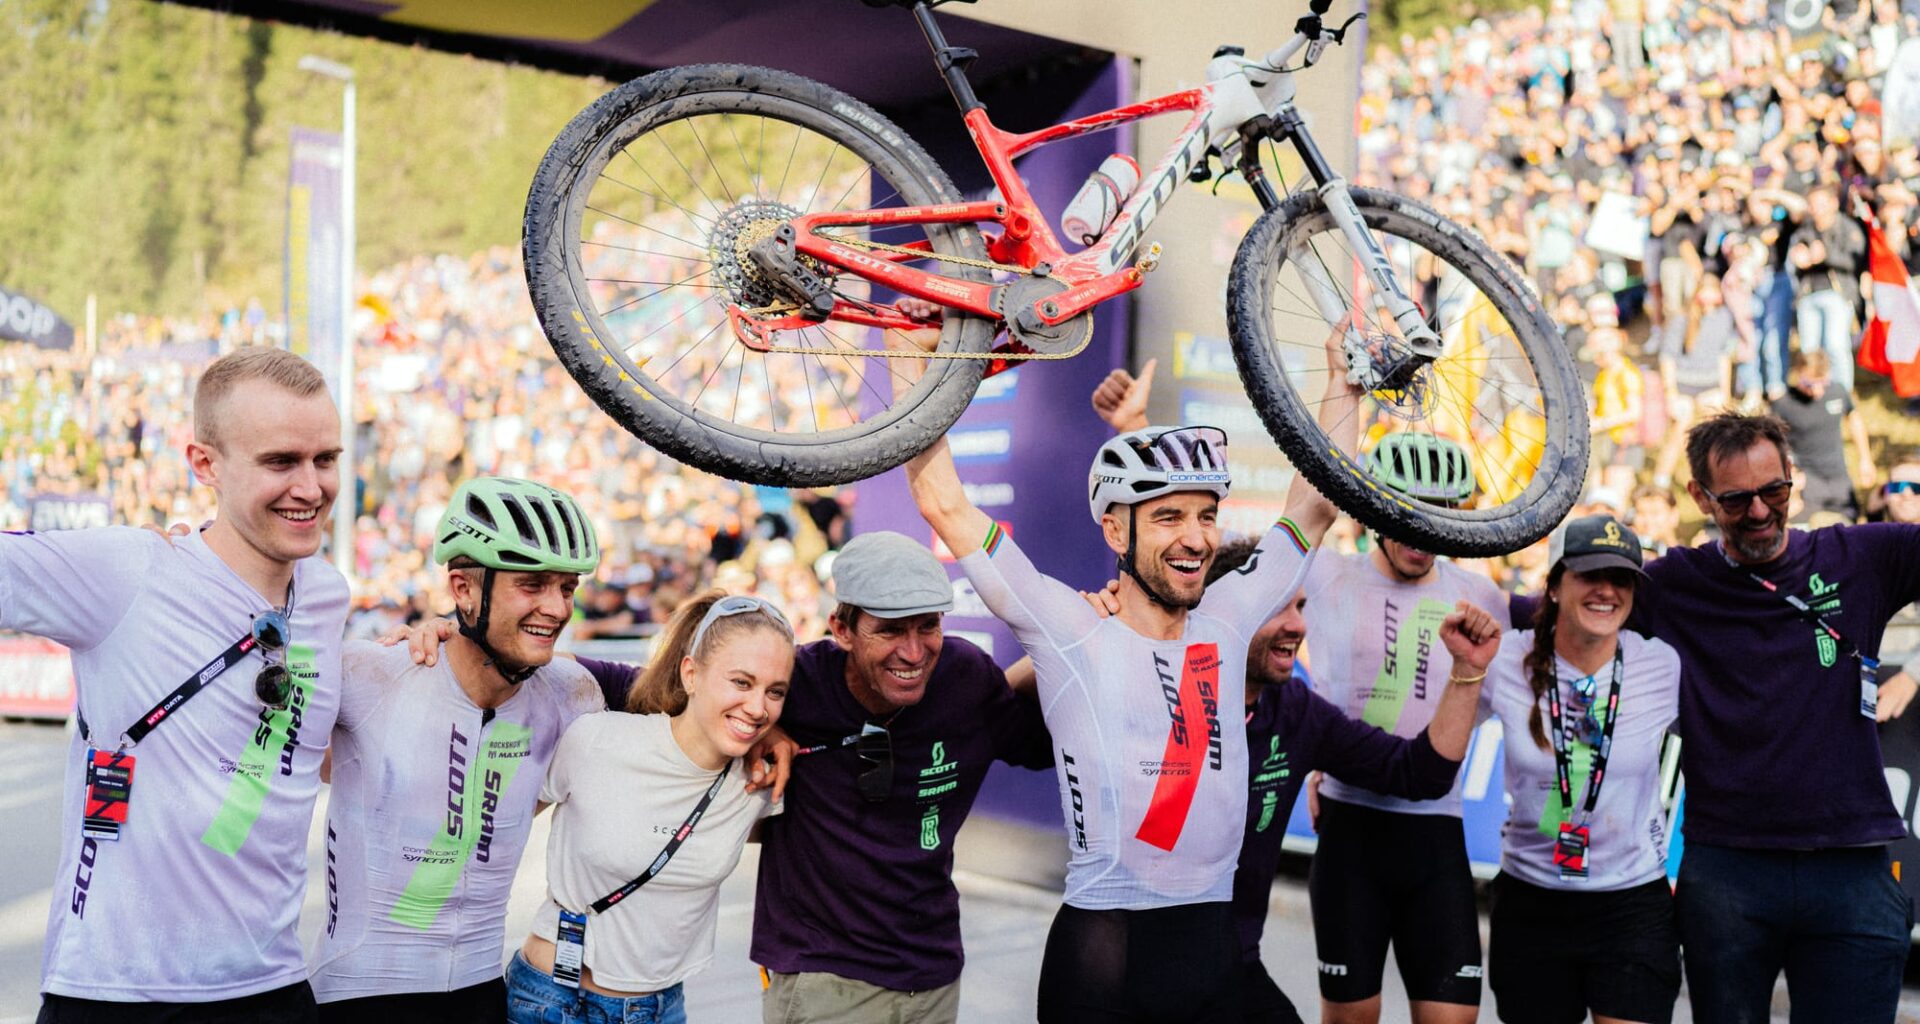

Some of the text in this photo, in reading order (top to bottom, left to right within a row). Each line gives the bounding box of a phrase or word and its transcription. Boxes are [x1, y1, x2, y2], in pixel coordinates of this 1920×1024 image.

[1110, 110, 1213, 267] SCOTT
[827, 243, 897, 274] SCOTT
[1092, 473, 1126, 485] SCOTT
[448, 516, 496, 544] SCOTT
[1383, 598, 1399, 680] SCOTT
[1414, 626, 1432, 701] SRAM
[164, 694, 184, 711] DATA
[280, 684, 305, 777] SRAM
[1153, 650, 1190, 751] SCOTT
[1197, 680, 1222, 772] SRAM
[447, 722, 468, 840] SCOTT
[918, 781, 958, 798] SRAM
[919, 761, 959, 777] SCOTT
[1061, 748, 1089, 852] SCOTT
[1140, 768, 1192, 776] syncros
[476, 768, 502, 864] SRAM
[652, 825, 695, 838] SCOT
[72, 836, 98, 921] SCO
[326, 817, 339, 940] SCOTT
[401, 853, 457, 865] syncros
